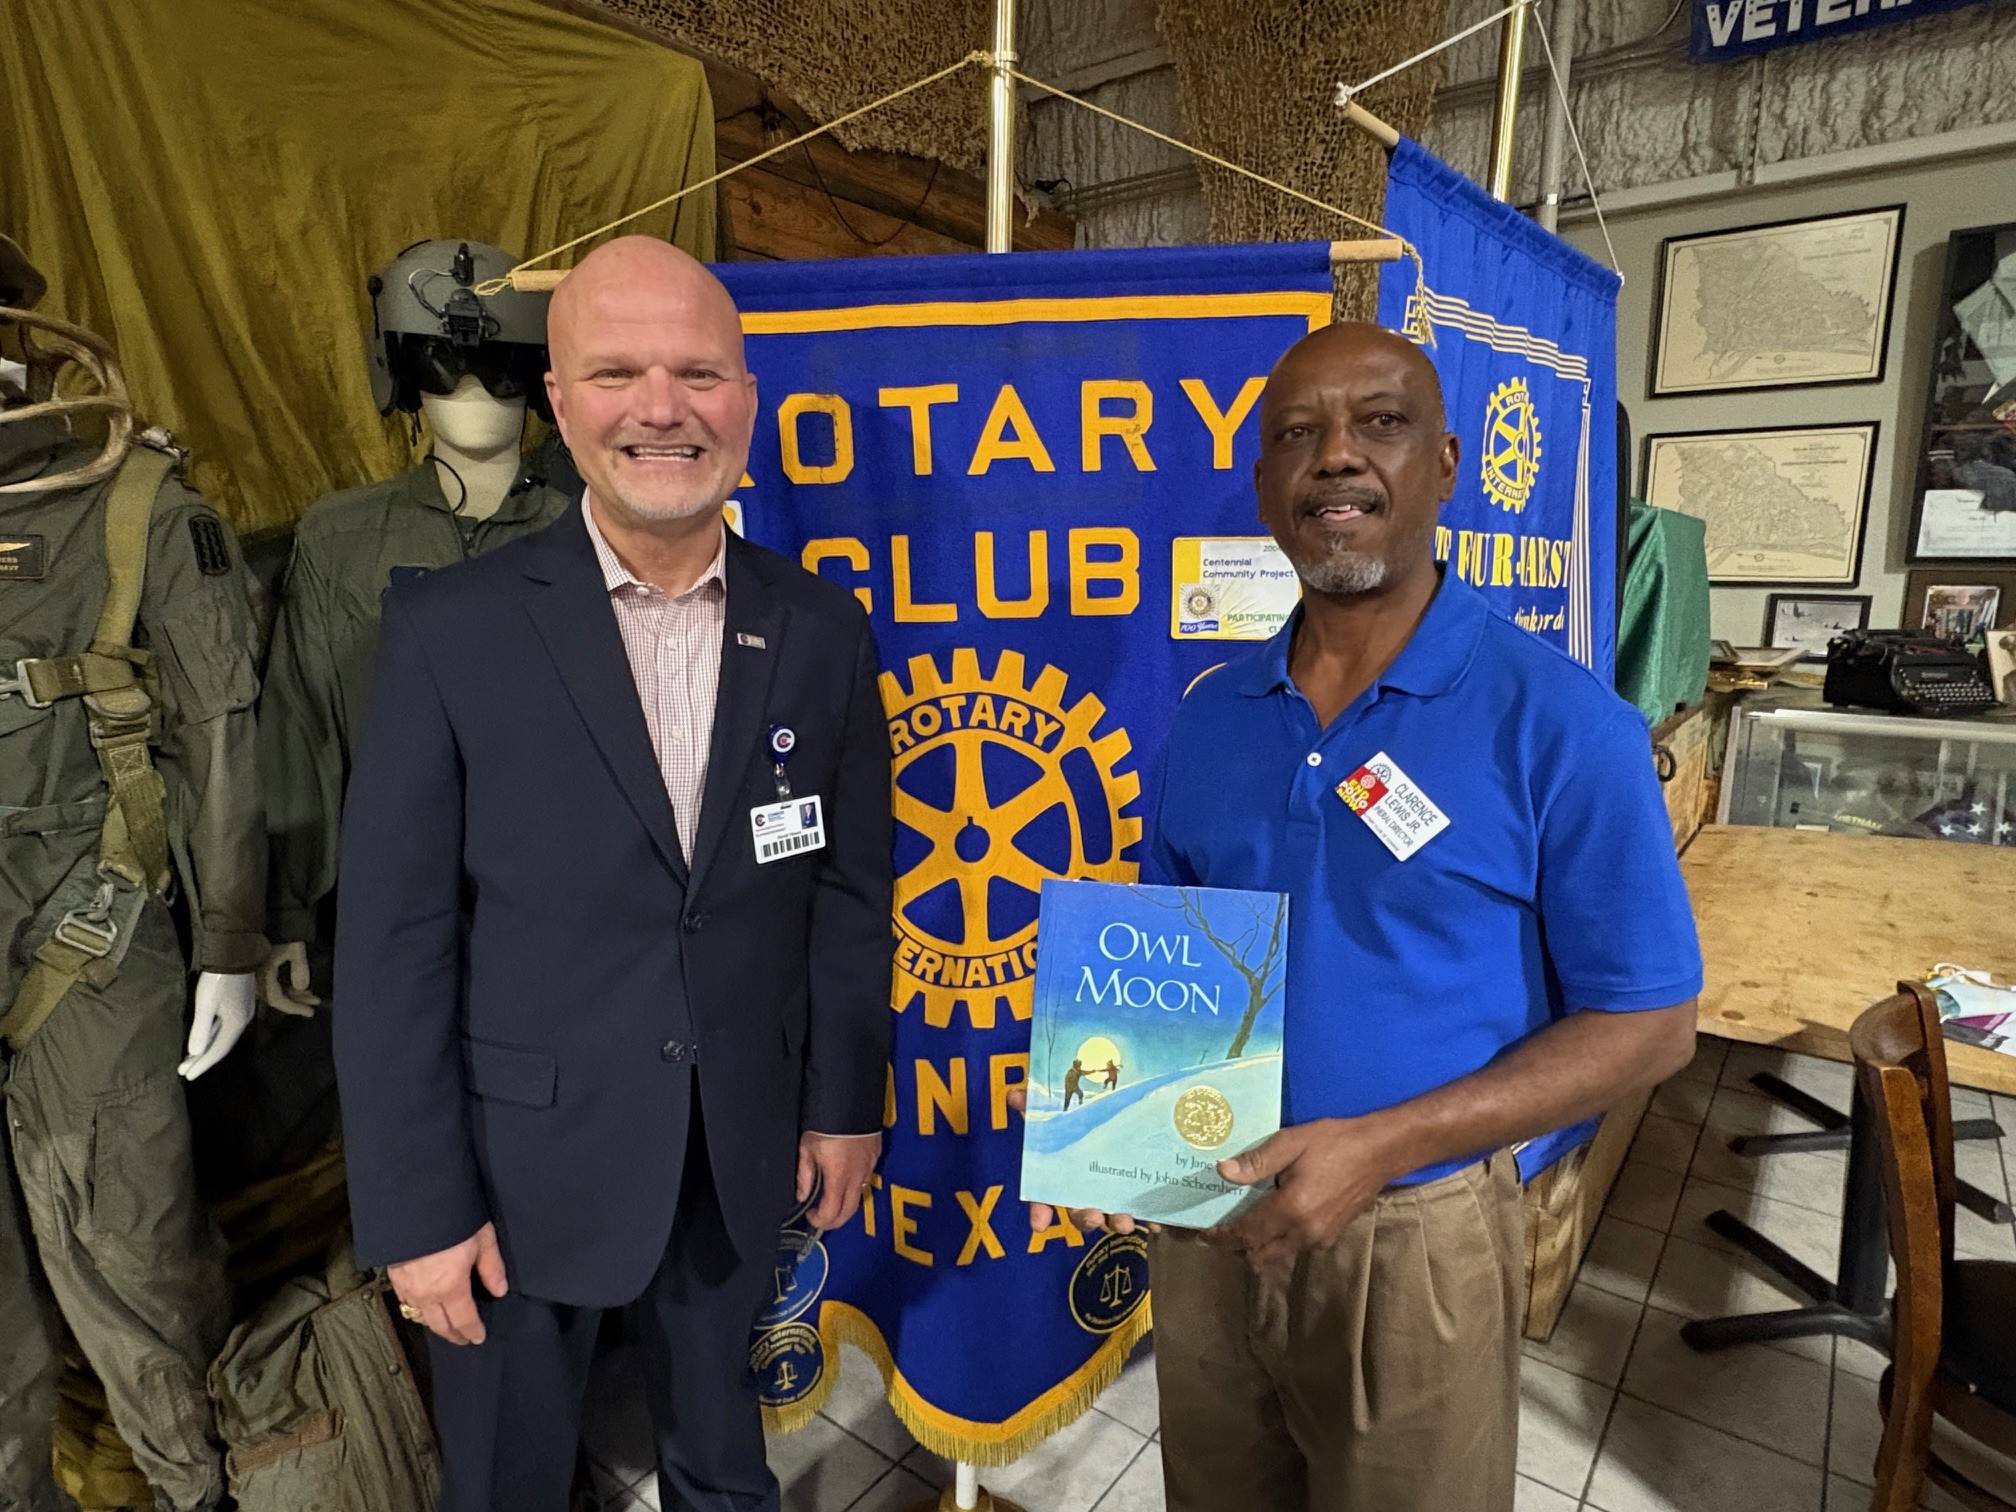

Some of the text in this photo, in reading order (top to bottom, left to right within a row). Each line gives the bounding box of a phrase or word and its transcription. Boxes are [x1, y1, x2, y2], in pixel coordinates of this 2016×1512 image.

[738, 376, 1269, 488] OTARY
[1202, 558, 1252, 567] Centennial
[1202, 570, 1294, 580] Community Project
[888, 694, 1061, 755] ROTARY
[1338, 780, 1368, 809] POLIO
[1347, 778, 1370, 800] END
[1384, 794, 1411, 821] LEWIS
[1394, 783, 1438, 827] CLARENCE
[1388, 820, 1414, 848] DIRECTOR
[1099, 922, 1202, 967] OWL
[1075, 965, 1220, 1015] MOON
[1089, 1160, 1138, 1179] illustrated
[1140, 1168, 1152, 1183] by
[1154, 1170, 1179, 1186] John
[1176, 1153, 1214, 1170] by Jane
